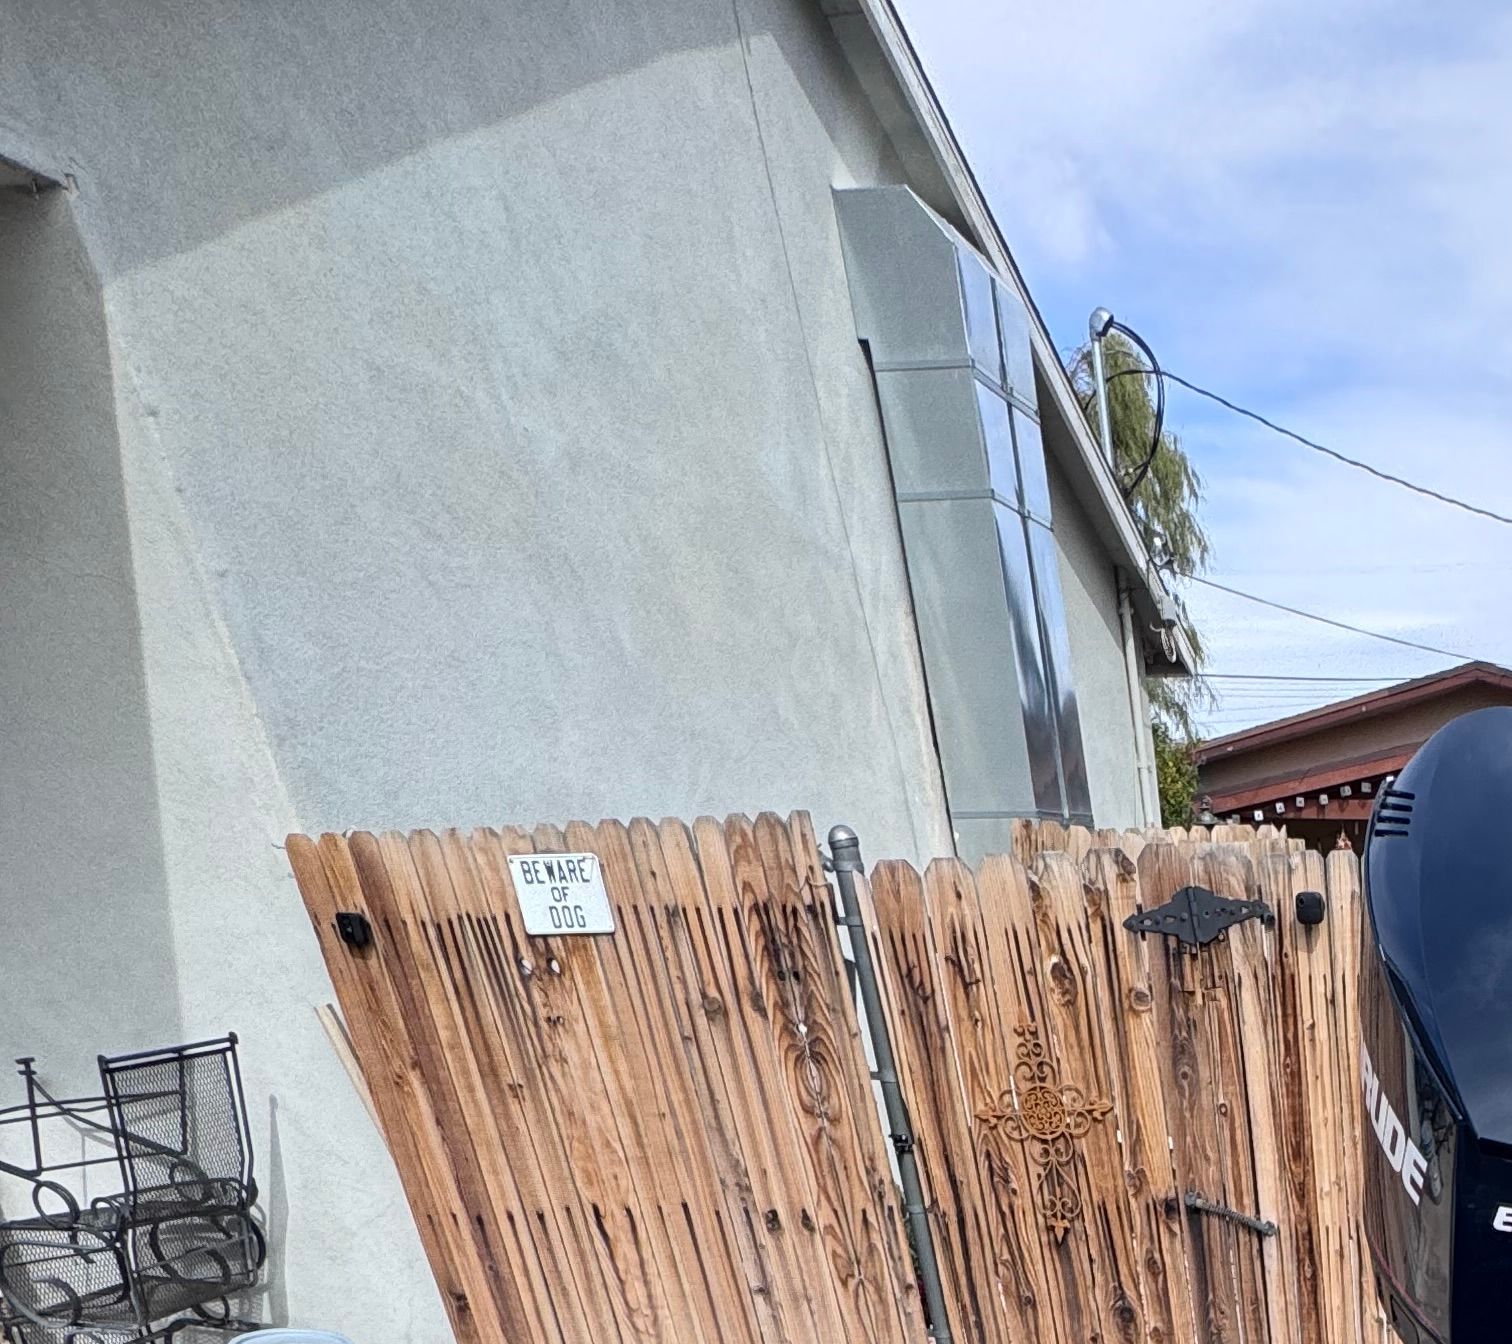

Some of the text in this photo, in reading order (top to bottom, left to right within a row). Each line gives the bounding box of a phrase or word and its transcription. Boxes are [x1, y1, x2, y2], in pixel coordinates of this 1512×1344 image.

[520, 859, 591, 884] BEWARE
[550, 886, 570, 902] OF
[548, 905, 587, 928] DOG
[1360, 1034, 1428, 1206] RUDE
